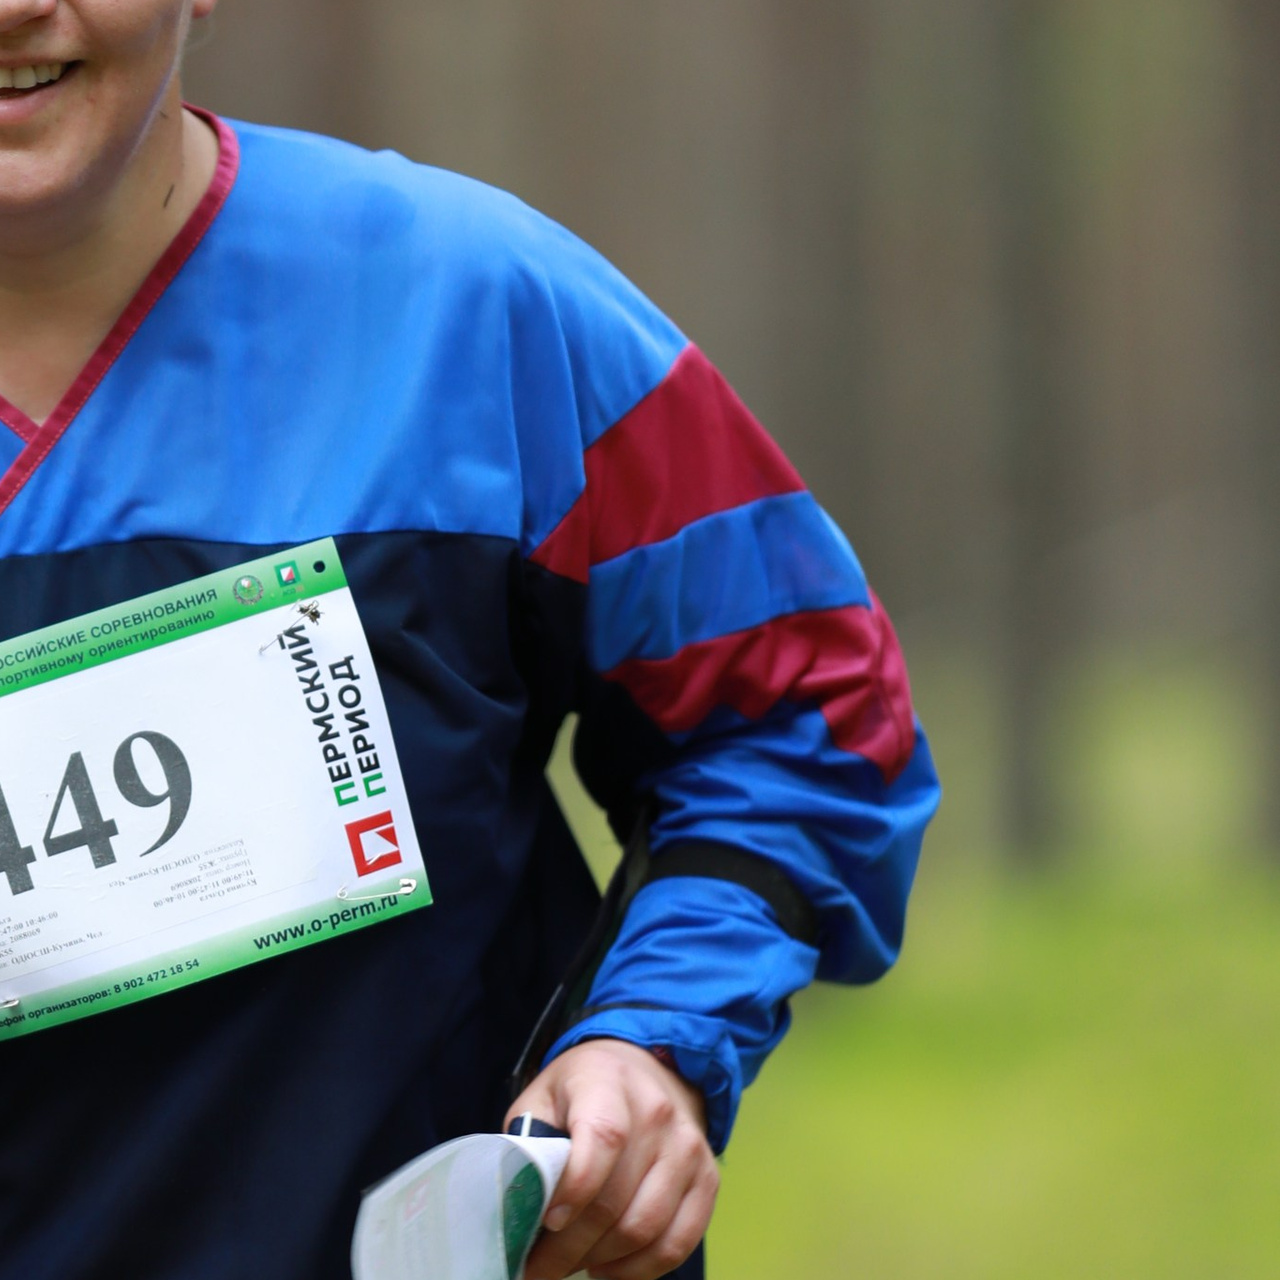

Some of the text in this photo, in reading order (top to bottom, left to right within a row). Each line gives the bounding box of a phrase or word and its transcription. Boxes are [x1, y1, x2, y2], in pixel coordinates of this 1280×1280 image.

[89, 609, 215, 658] ориентированию
[90, 588, 218, 639] СОРЕВНОВАНИЯ
[277, 624, 359, 807] ПЕРМСКИЙ
[328, 654, 387, 798] ПЕРИОД
[253, 894, 398, 950] www.o-perm.ru
[28, 989, 111, 1019] организаторов:
[114, 984, 122, 994] 8
[123, 976, 145, 991] 902
[146, 969, 168, 983] 472
[169, 964, 184, 976] 18
[185, 958, 200, 971] 54
